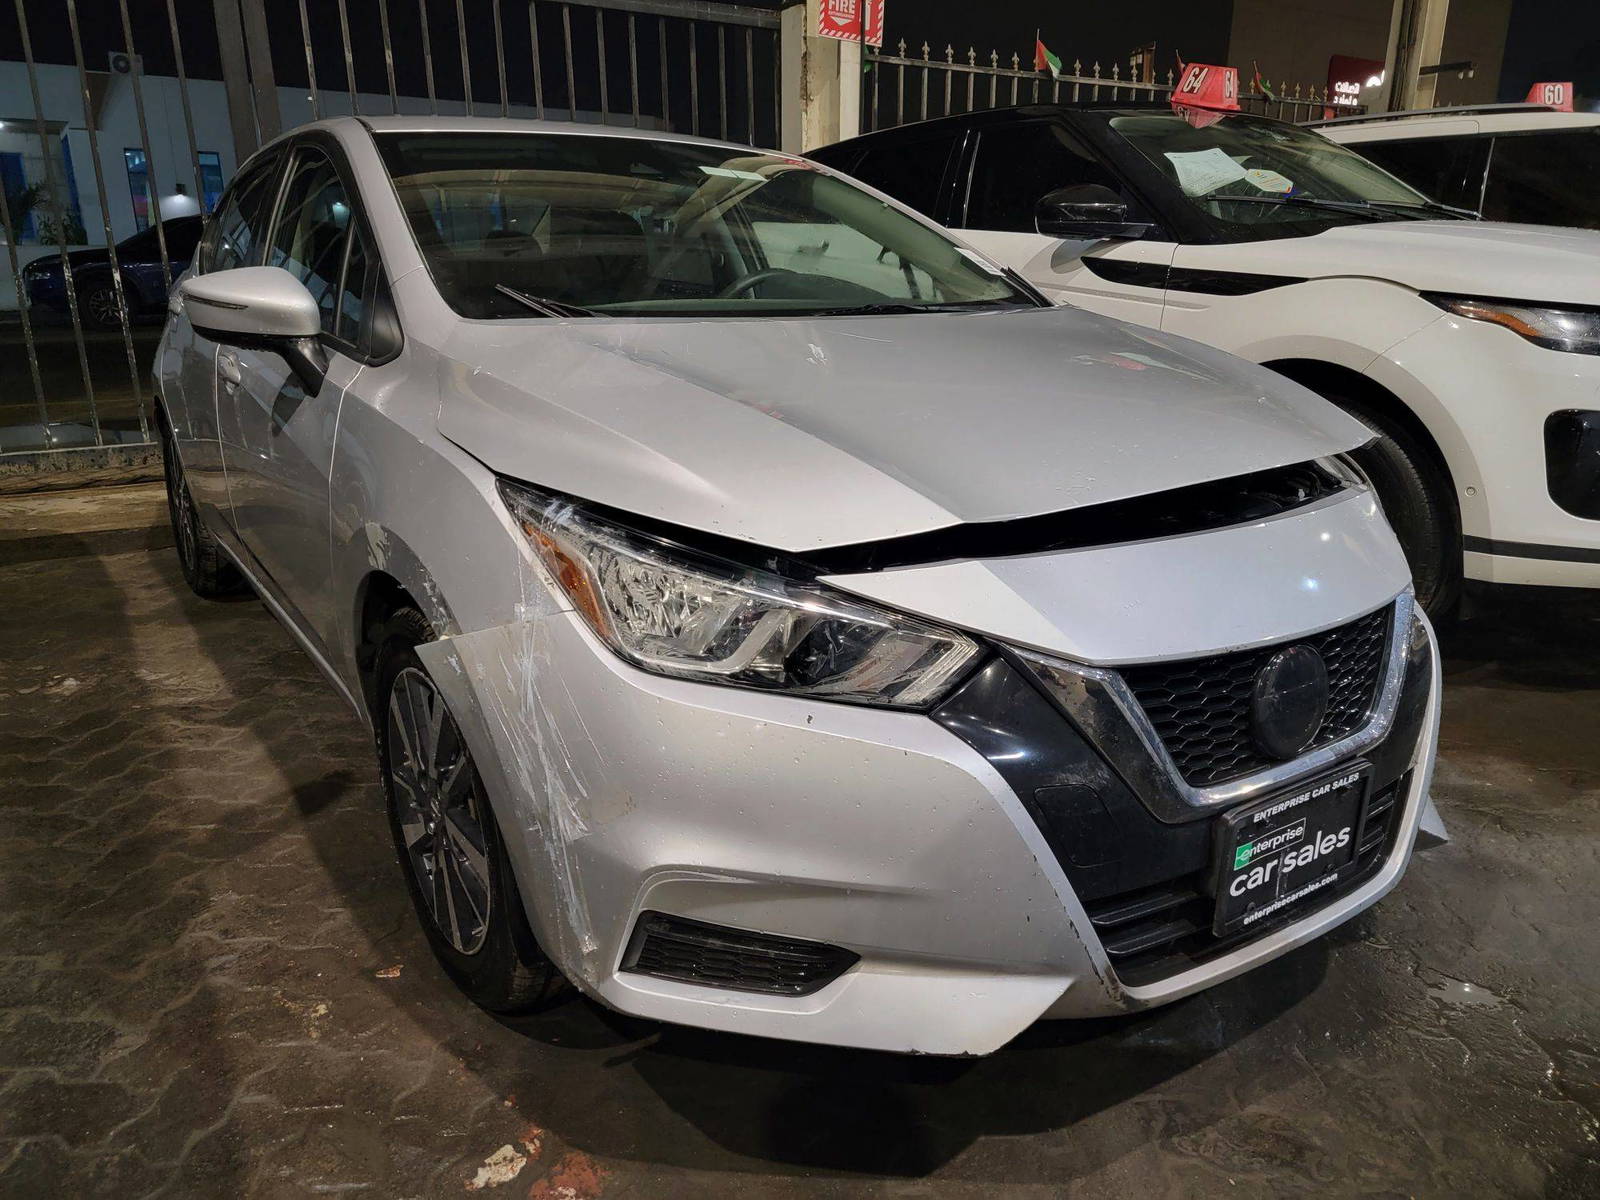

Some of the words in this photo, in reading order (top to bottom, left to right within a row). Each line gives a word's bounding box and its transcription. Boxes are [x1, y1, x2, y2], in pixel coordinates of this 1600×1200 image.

[828, 0, 855, 14] FIRE
[1183, 67, 1209, 93] 64
[1225, 70, 1234, 98] 64
[1545, 84, 1563, 105] 60
[1253, 792, 1310, 823] ENTERPRISE
[1312, 784, 1331, 797] CAR
[1332, 772, 1360, 790] SALES
[1237, 826, 1303, 861] enterprise
[1230, 858, 1278, 897] car
[1282, 827, 1350, 873] sales
[1243, 873, 1338, 925] enterprisecarsales.com
